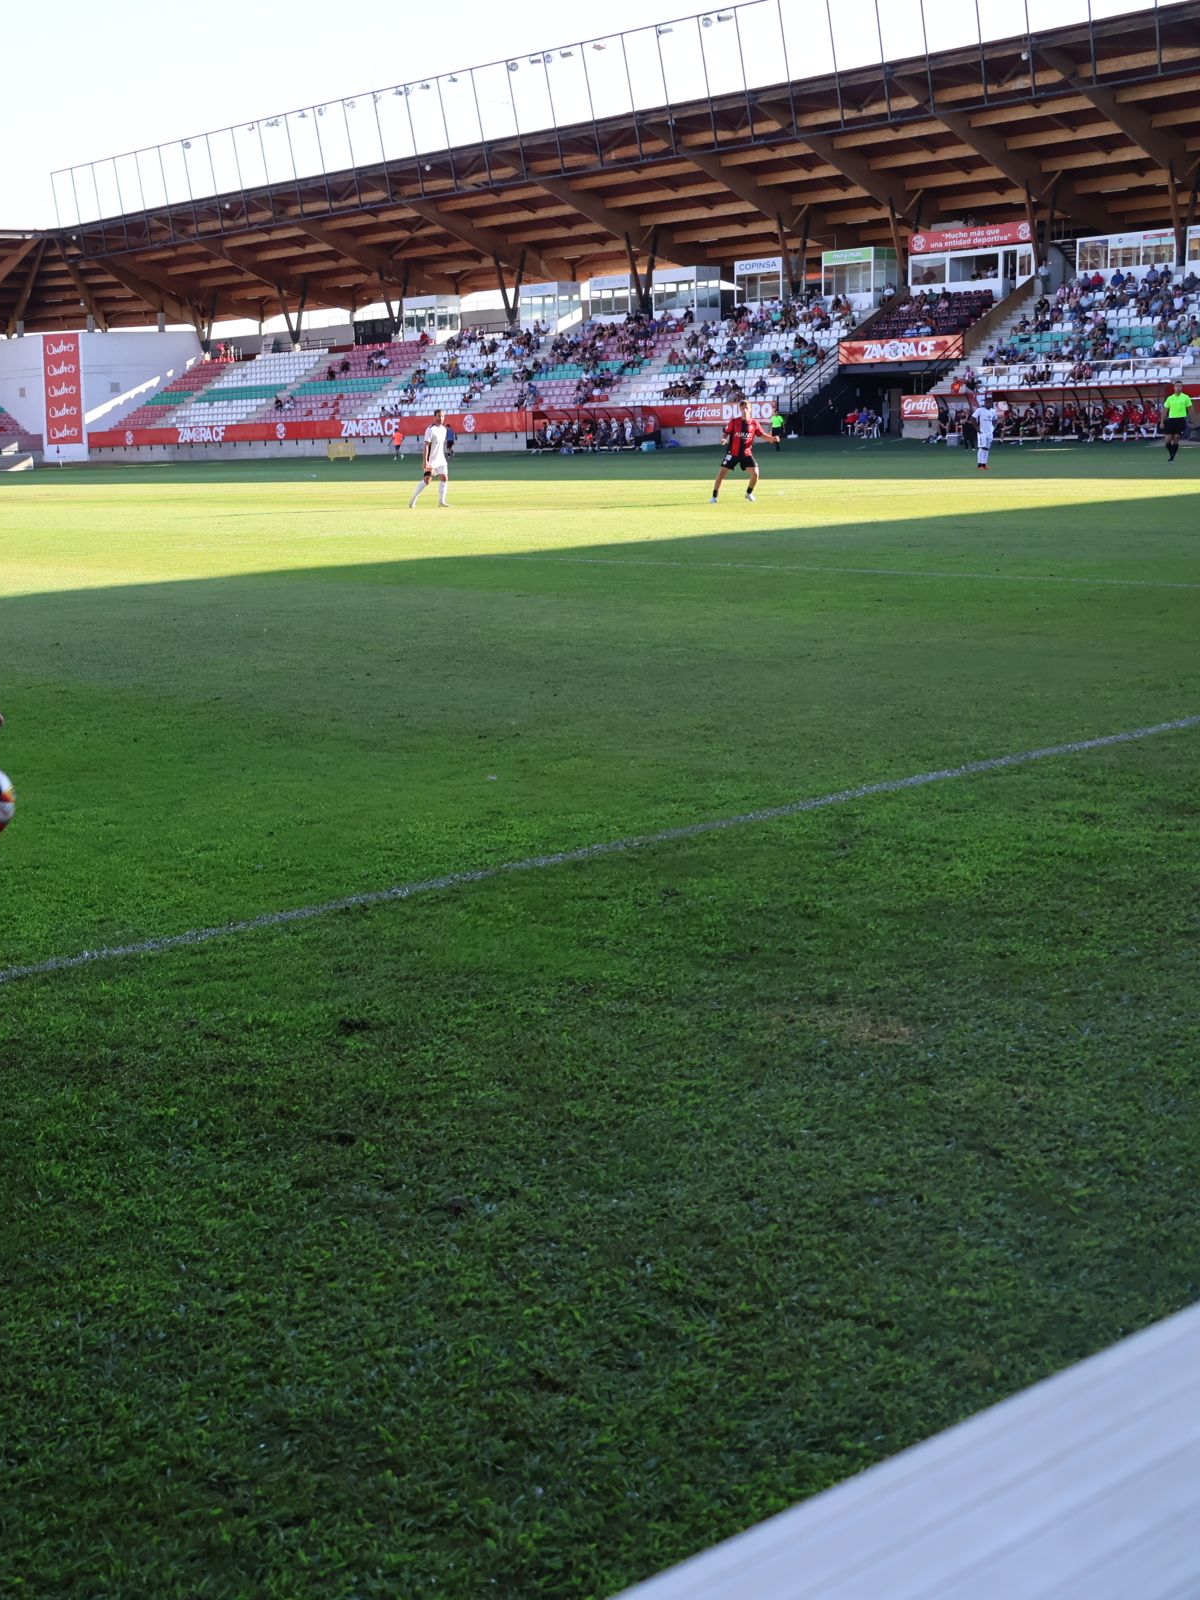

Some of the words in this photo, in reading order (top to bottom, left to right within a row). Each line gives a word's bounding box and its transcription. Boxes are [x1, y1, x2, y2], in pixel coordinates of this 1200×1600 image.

[969, 229, 985, 237] más
[986, 228, 1000, 237] que
[944, 238, 971, 247] entidad
[738, 260, 777, 271] COPINSA
[918, 340, 936, 356] CF
[684, 405, 721, 421] Gráficas
[722, 403, 773, 420] DURO
[903, 398, 938, 414] Gráfic
[177, 427, 213, 443] ZAMORA
[213, 426, 225, 441] CF
[340, 419, 384, 437] ZAMORA
